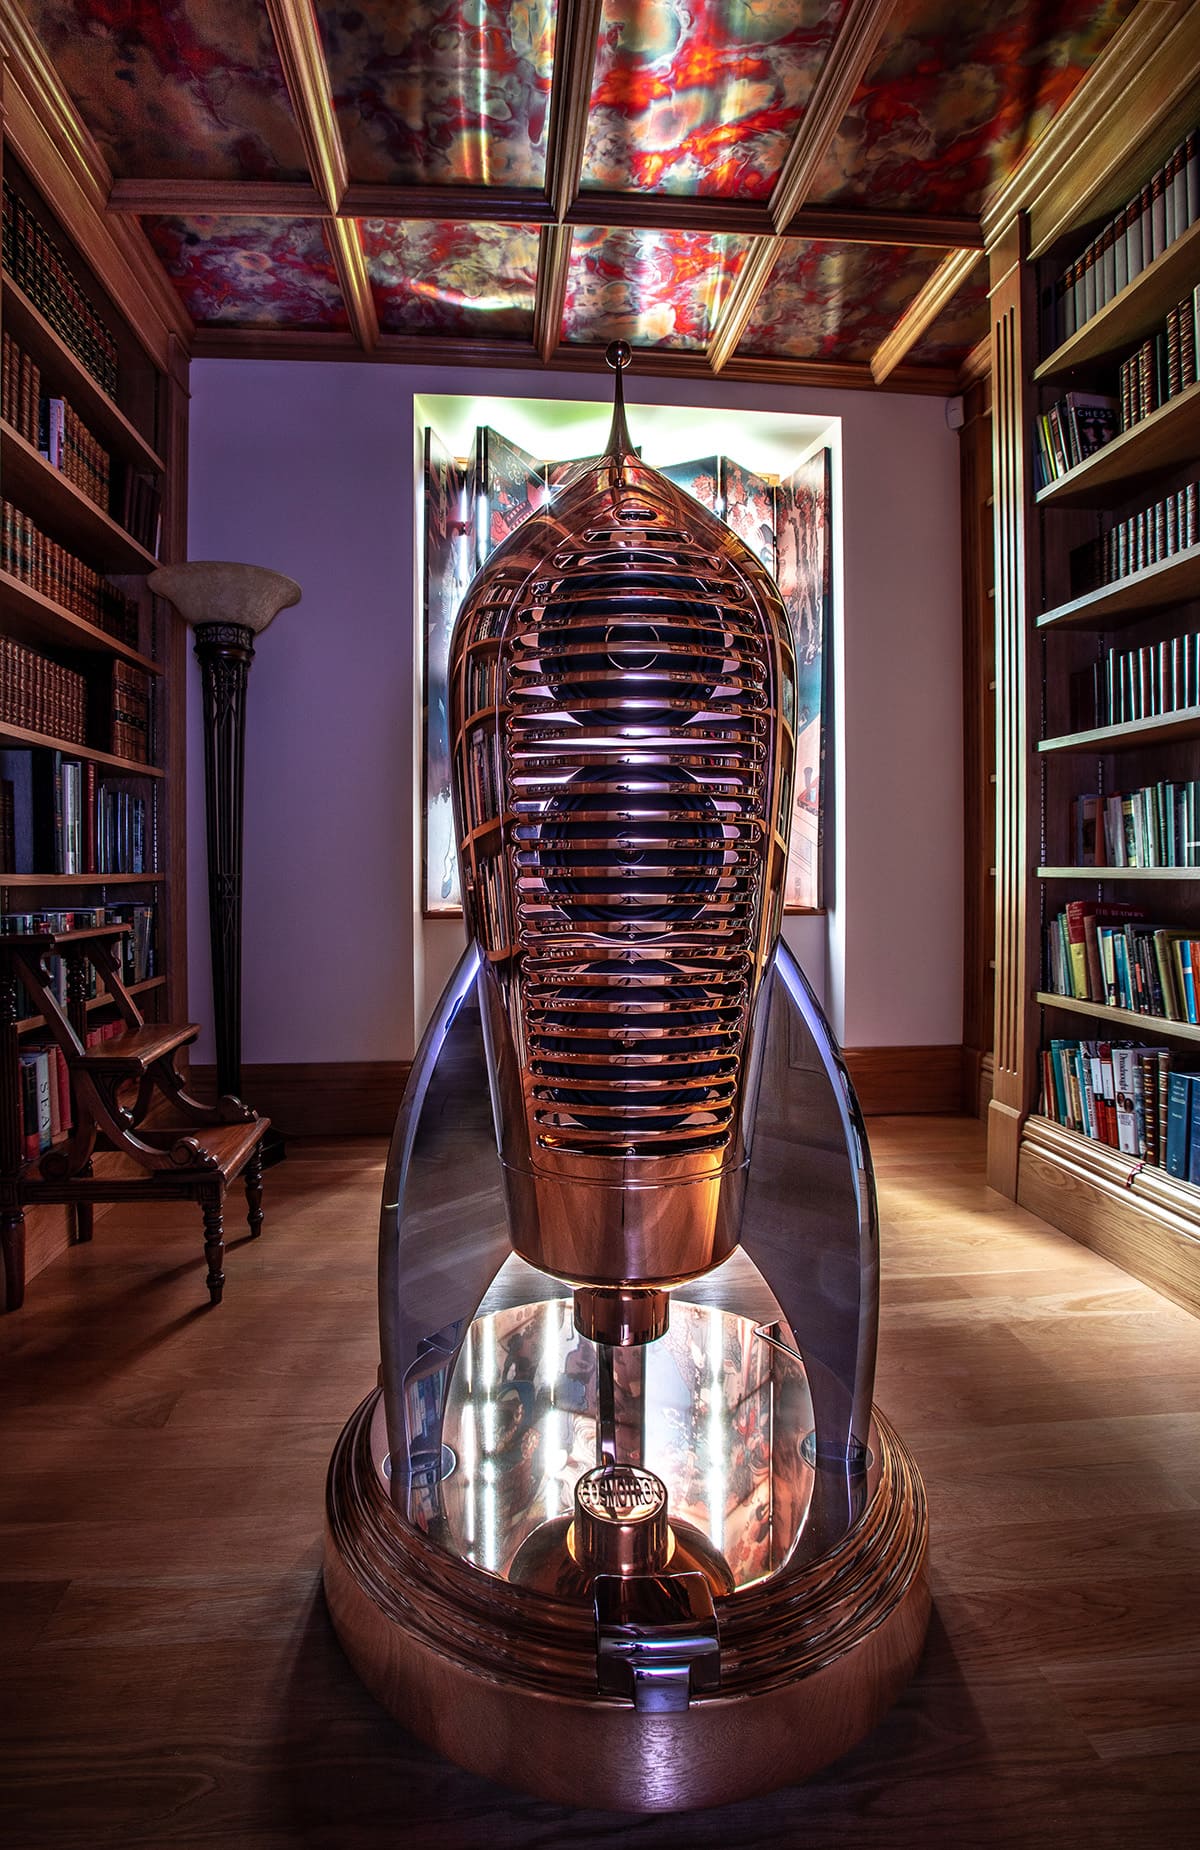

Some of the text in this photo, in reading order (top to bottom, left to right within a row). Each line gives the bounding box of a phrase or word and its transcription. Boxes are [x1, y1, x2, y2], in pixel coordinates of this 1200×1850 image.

[1077, 408, 1113, 418] CHESS
[40, 1081, 50, 1128] SEA
[579, 1478, 664, 1507] COSMOTRON
